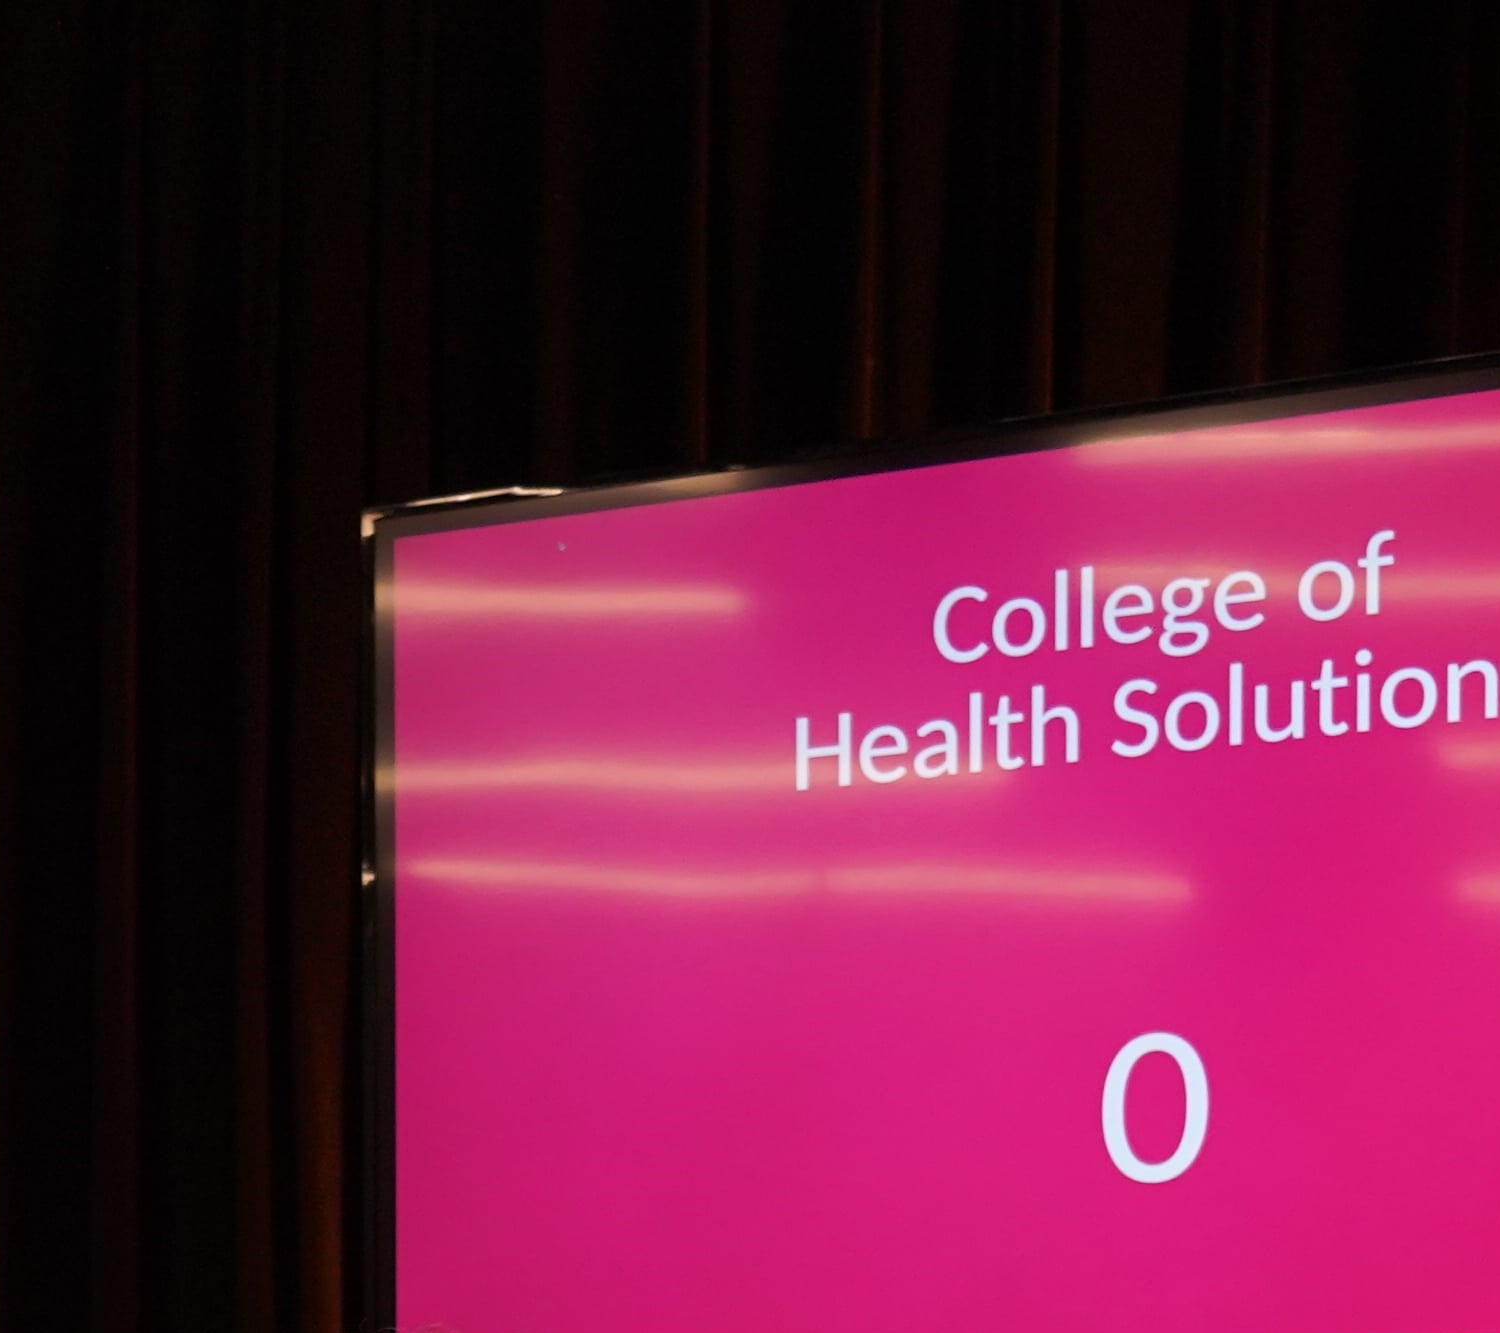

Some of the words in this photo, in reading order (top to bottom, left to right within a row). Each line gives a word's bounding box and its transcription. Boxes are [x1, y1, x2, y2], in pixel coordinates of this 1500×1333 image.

[932, 562, 1268, 663] College
[1297, 529, 1396, 622] of
[794, 685, 1080, 792] Health
[1101, 1031, 1210, 1184] 0
